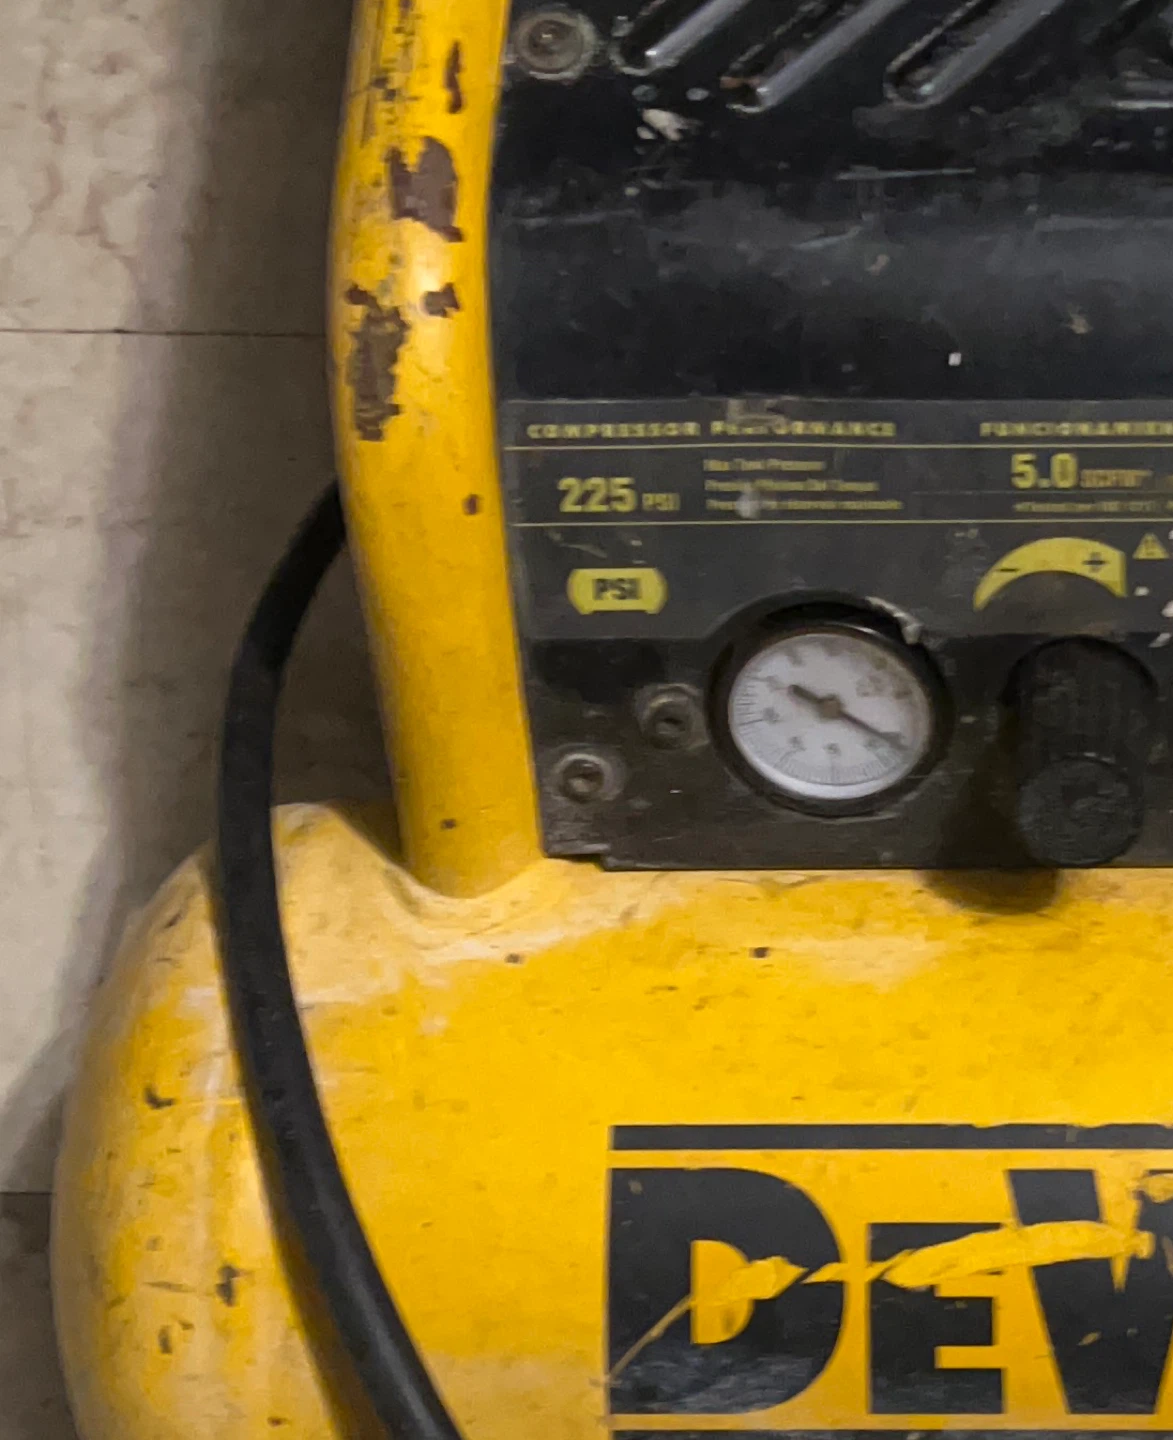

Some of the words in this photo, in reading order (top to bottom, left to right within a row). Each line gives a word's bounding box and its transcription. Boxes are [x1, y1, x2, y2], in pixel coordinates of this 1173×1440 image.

[527, 422, 700, 439] COMPRESSOR
[1010, 452, 1078, 489] 5.0
[557, 476, 638, 513] 225
[642, 492, 681, 512] PSI
[591, 577, 641, 601] PSI
